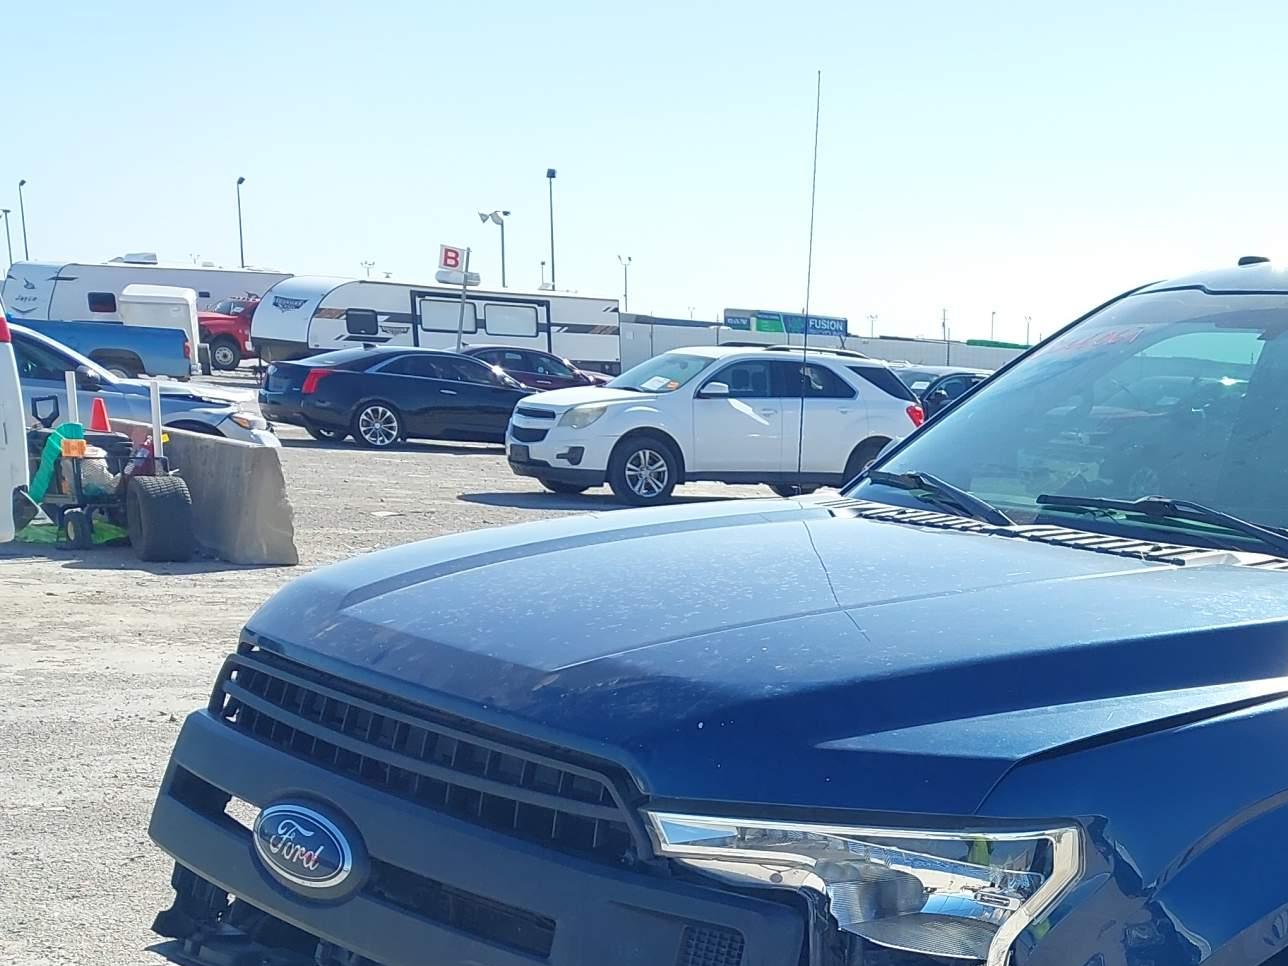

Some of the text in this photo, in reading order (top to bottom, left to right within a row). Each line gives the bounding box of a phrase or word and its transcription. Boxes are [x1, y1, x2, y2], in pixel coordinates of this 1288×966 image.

[443, 248, 459, 268] B
[809, 319, 843, 331] FUSION
[270, 819, 324, 870] Ford
